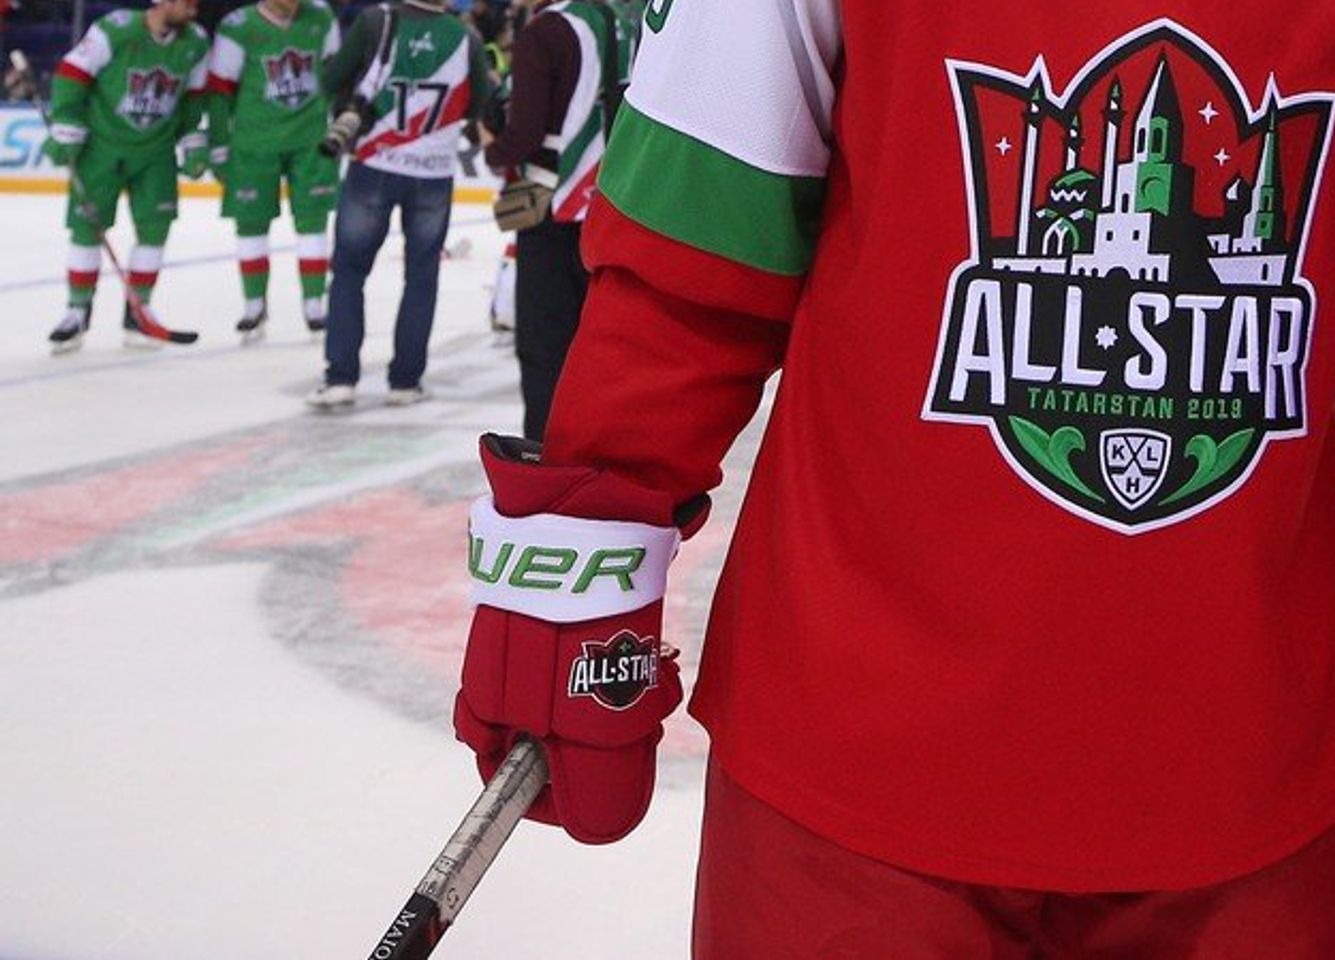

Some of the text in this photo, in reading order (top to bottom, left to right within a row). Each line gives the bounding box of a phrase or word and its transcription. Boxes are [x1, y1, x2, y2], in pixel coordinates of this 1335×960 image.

[389, 79, 450, 135] 17
[1028, 388, 1243, 419] TATARSTAN 2019
[367, 909, 417, 960] MAIO
